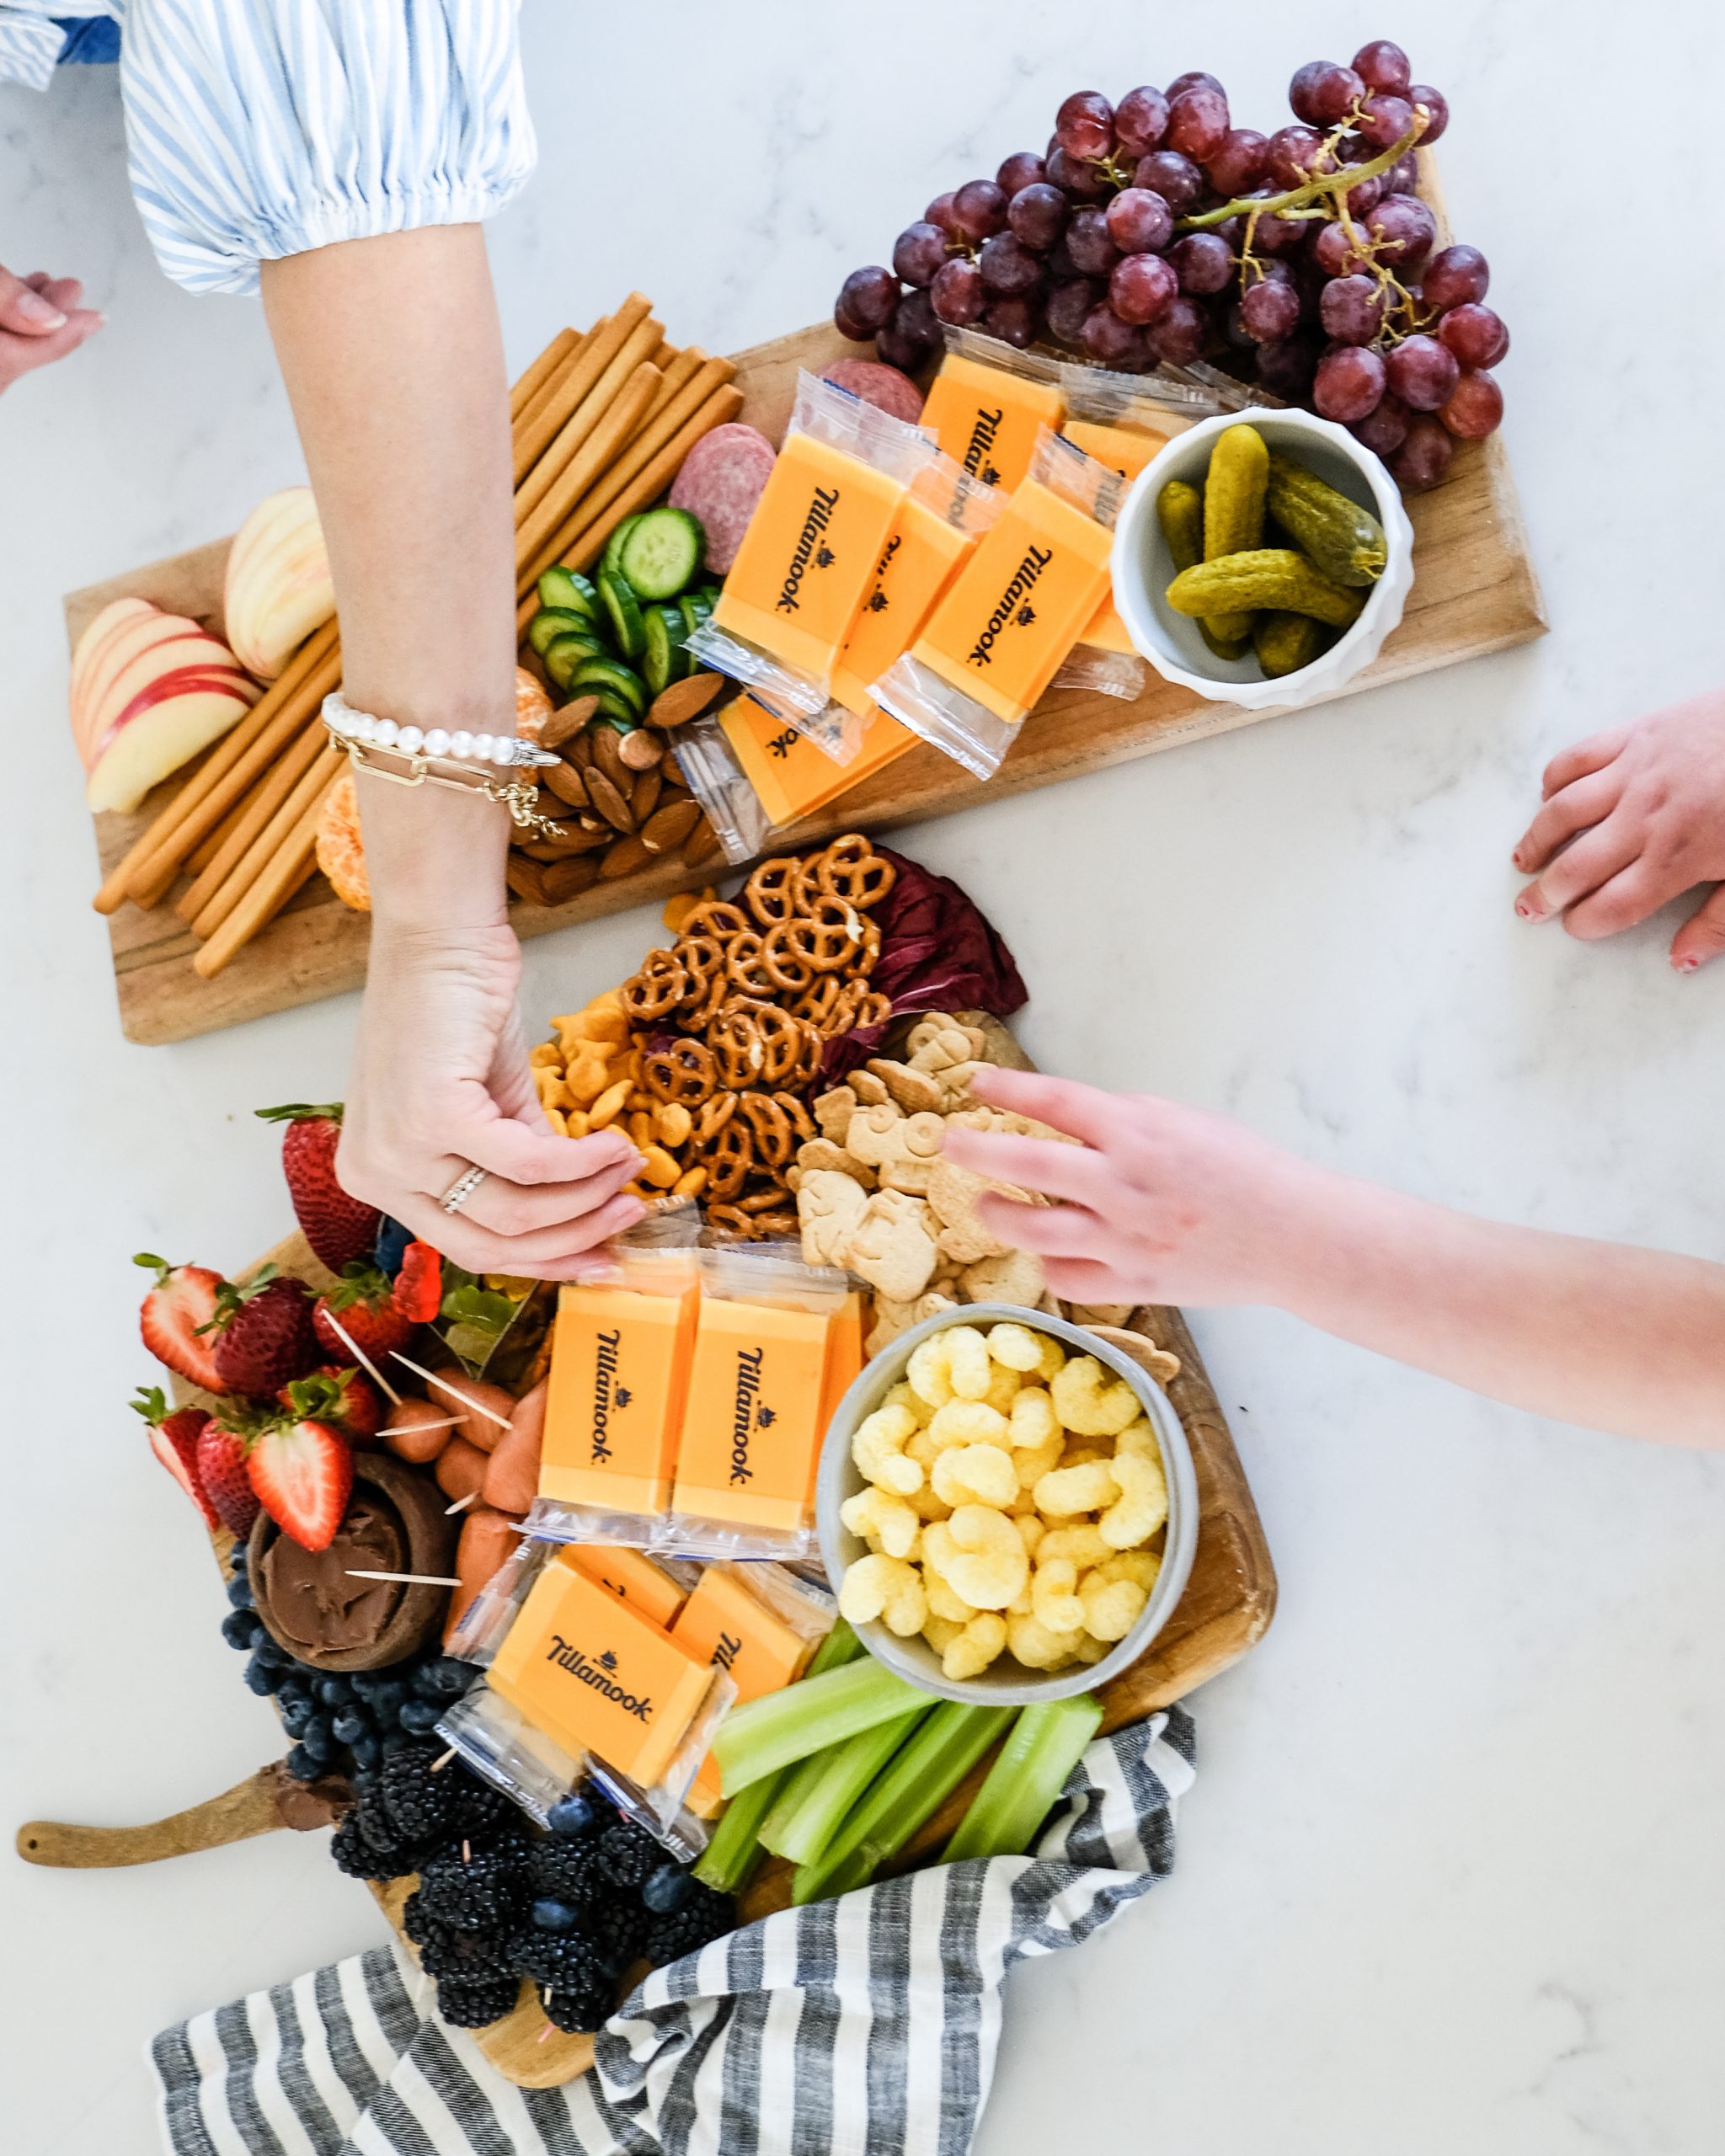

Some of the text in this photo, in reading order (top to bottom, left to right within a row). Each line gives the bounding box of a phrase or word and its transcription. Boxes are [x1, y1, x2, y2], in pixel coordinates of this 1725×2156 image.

[777, 487, 840, 614] Tillamook
[969, 545, 1053, 667] Tillamook
[592, 1329, 621, 1464] Tillamook
[729, 1348, 764, 1486] Tillamook
[546, 1635, 654, 1722] Tillamook
